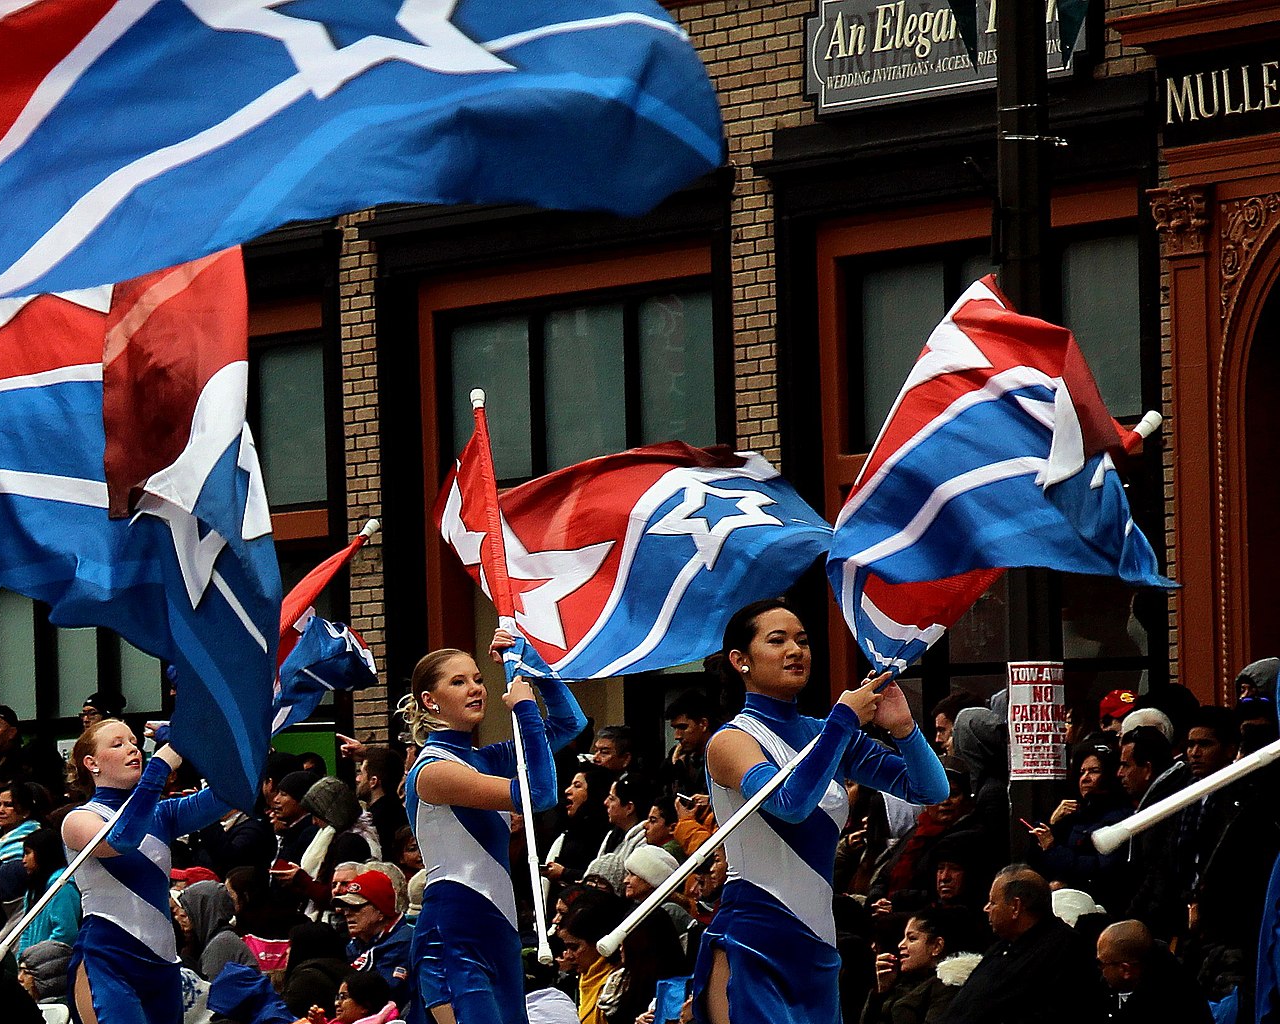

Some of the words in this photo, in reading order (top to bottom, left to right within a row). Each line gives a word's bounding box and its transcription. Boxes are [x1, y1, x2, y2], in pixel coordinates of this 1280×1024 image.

[824, 11, 867, 61] An
[872, 1, 963, 58] Elegan
[827, 70, 870, 90] WEDDING
[872, 60, 930, 84] INVITATIONS
[935, 49, 998, 74] ACCESSRIES
[1166, 61, 1280, 125] MULLE
[1033, 685, 1054, 703] NO
